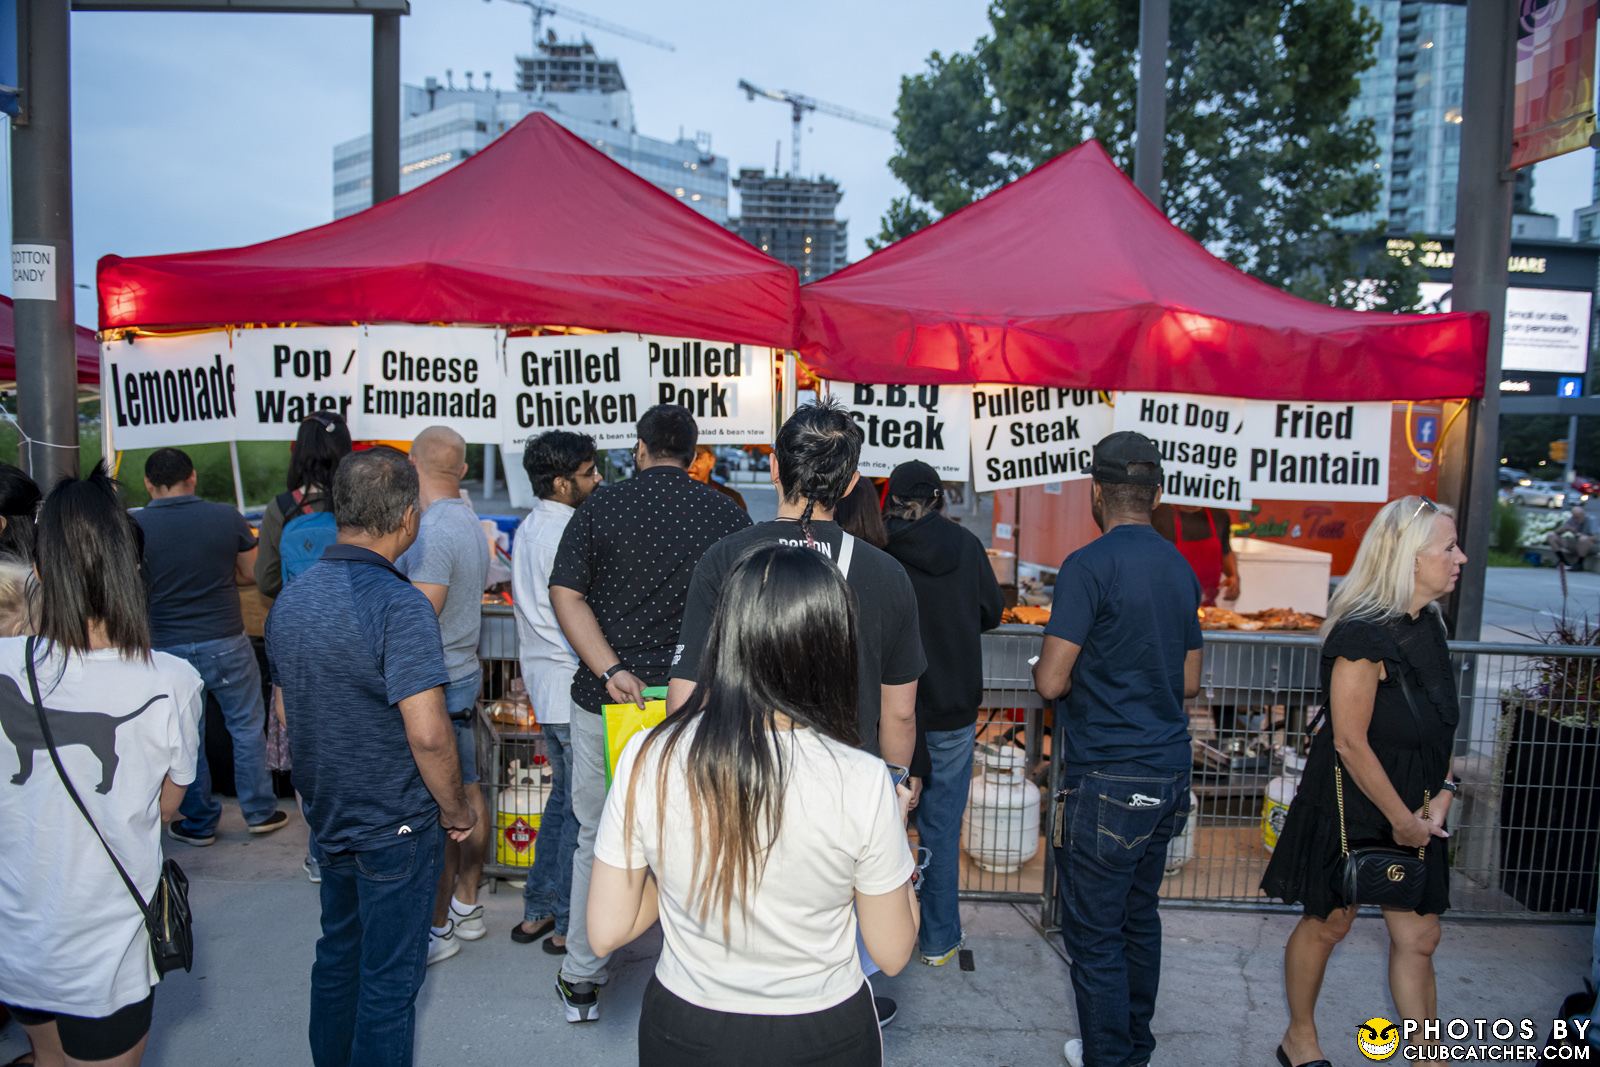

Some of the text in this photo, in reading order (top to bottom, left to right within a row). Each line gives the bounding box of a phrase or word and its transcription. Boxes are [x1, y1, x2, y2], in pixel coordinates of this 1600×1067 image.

[13, 269, 46, 282] CANDY
[273, 344, 356, 381] Pop /
[382, 350, 478, 383] Cheese
[521, 346, 621, 387] Grilled
[648, 341, 741, 377] Pulled
[111, 354, 237, 427] Lemonade
[255, 390, 352, 424] Water
[363, 384, 497, 419] Empanada
[658, 382, 728, 418] Pork
[853, 383, 939, 413] B.B.Q
[973, 387, 1050, 420] Pulled
[516, 389, 637, 428] Chicken
[1140, 398, 1178, 425] Hot
[1185, 403, 1230, 433] Dog
[1275, 404, 1354, 439] Fried
[726, 428, 745, 436] bean
[985, 415, 1080, 451] / Steak
[986, 444, 1099, 482] Sandwic
[1250, 448, 1380, 485] Plantain
